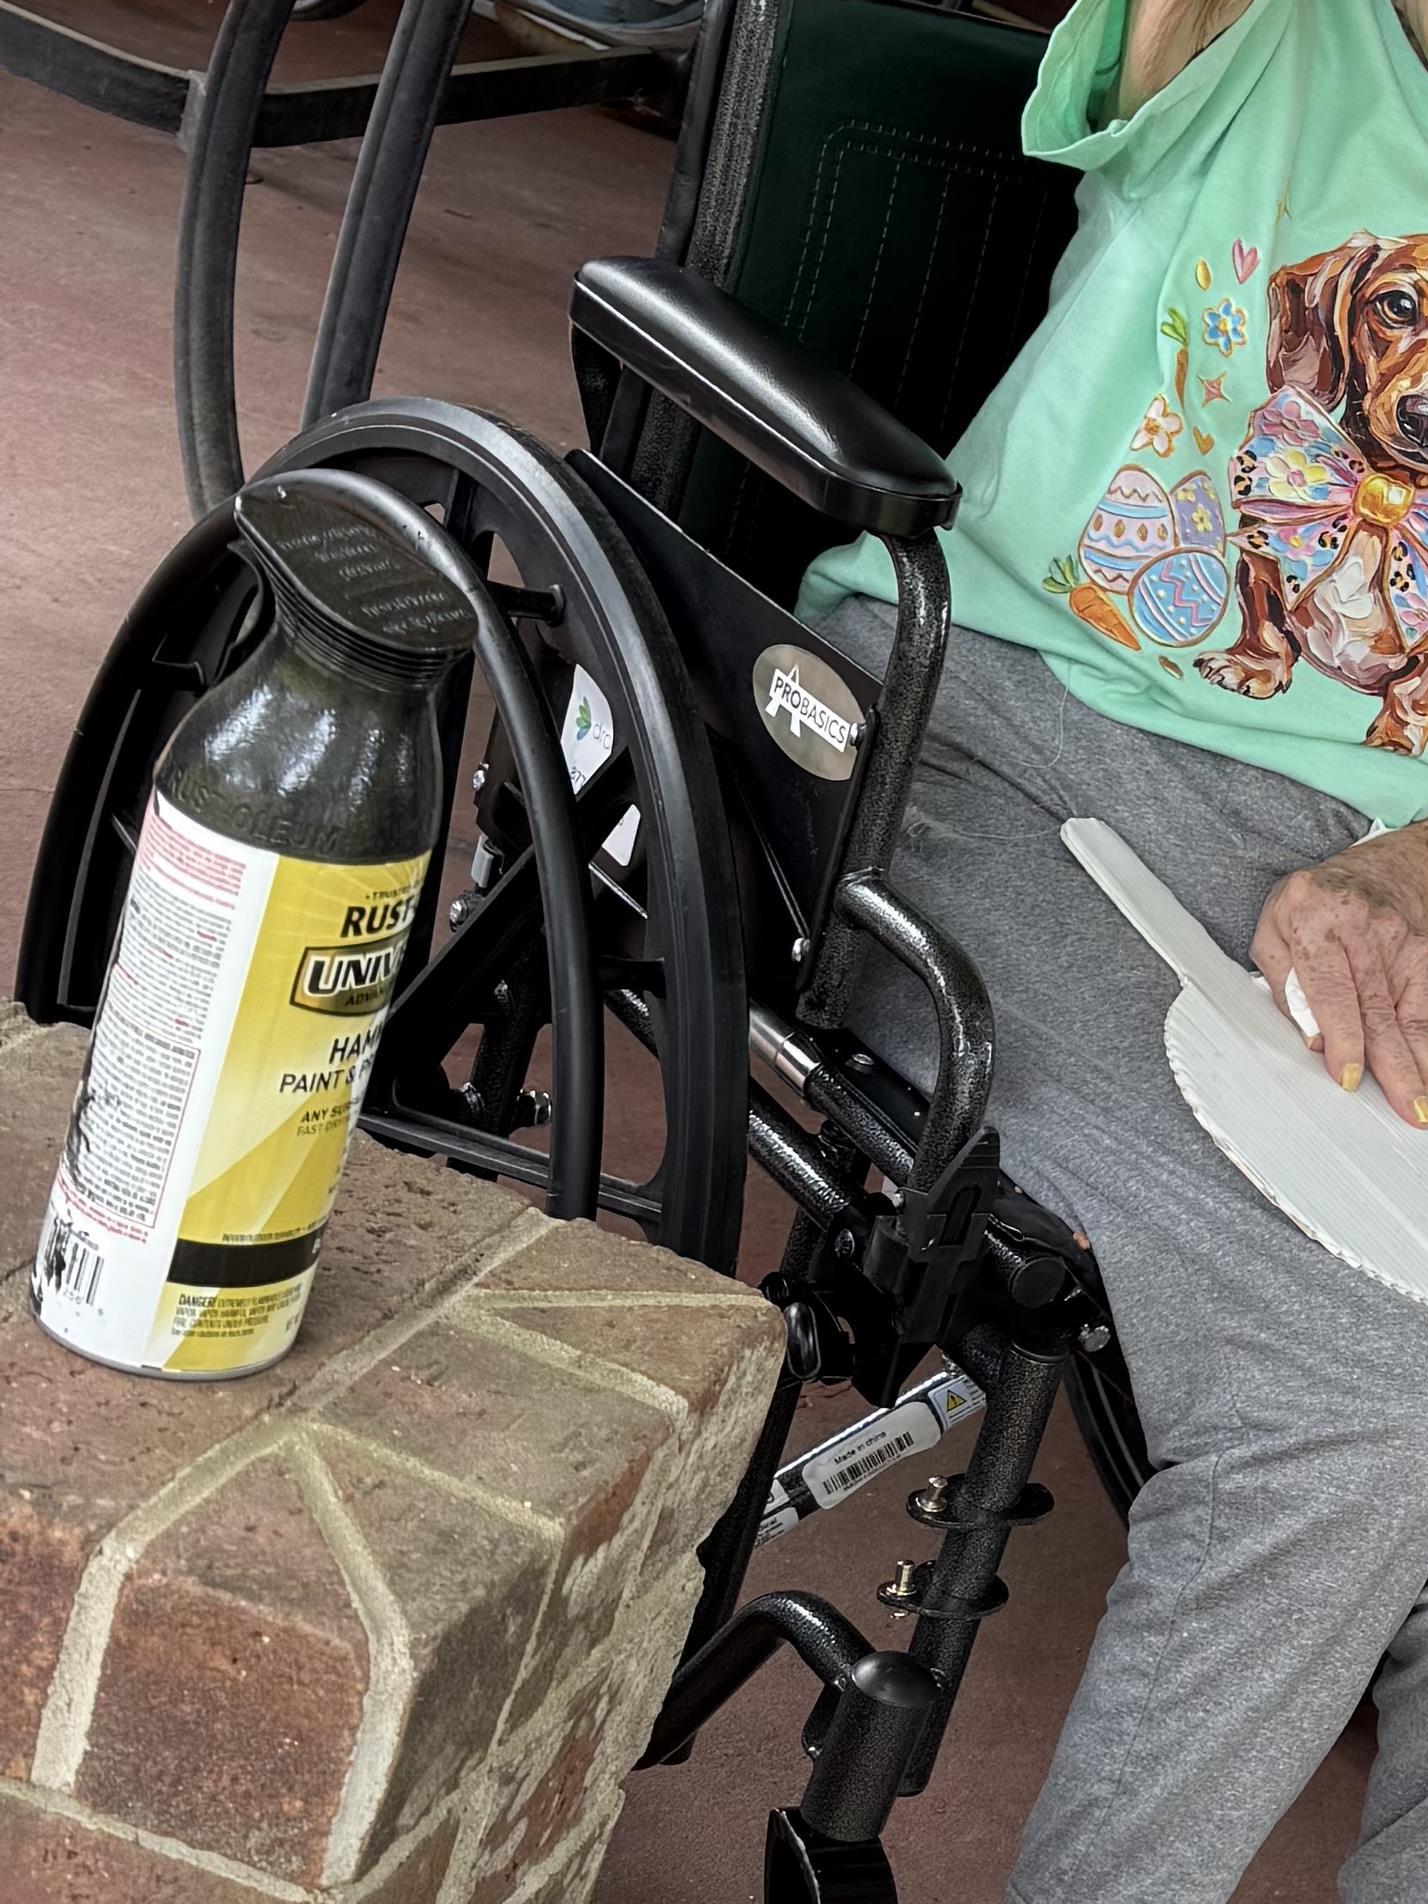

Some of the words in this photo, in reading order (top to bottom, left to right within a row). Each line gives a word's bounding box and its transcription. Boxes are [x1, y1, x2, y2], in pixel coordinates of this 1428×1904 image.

[774, 677, 847, 744] PROBASICS
[279, 1069, 345, 1094] PAINT
[300, 1108, 329, 1123] ANY
